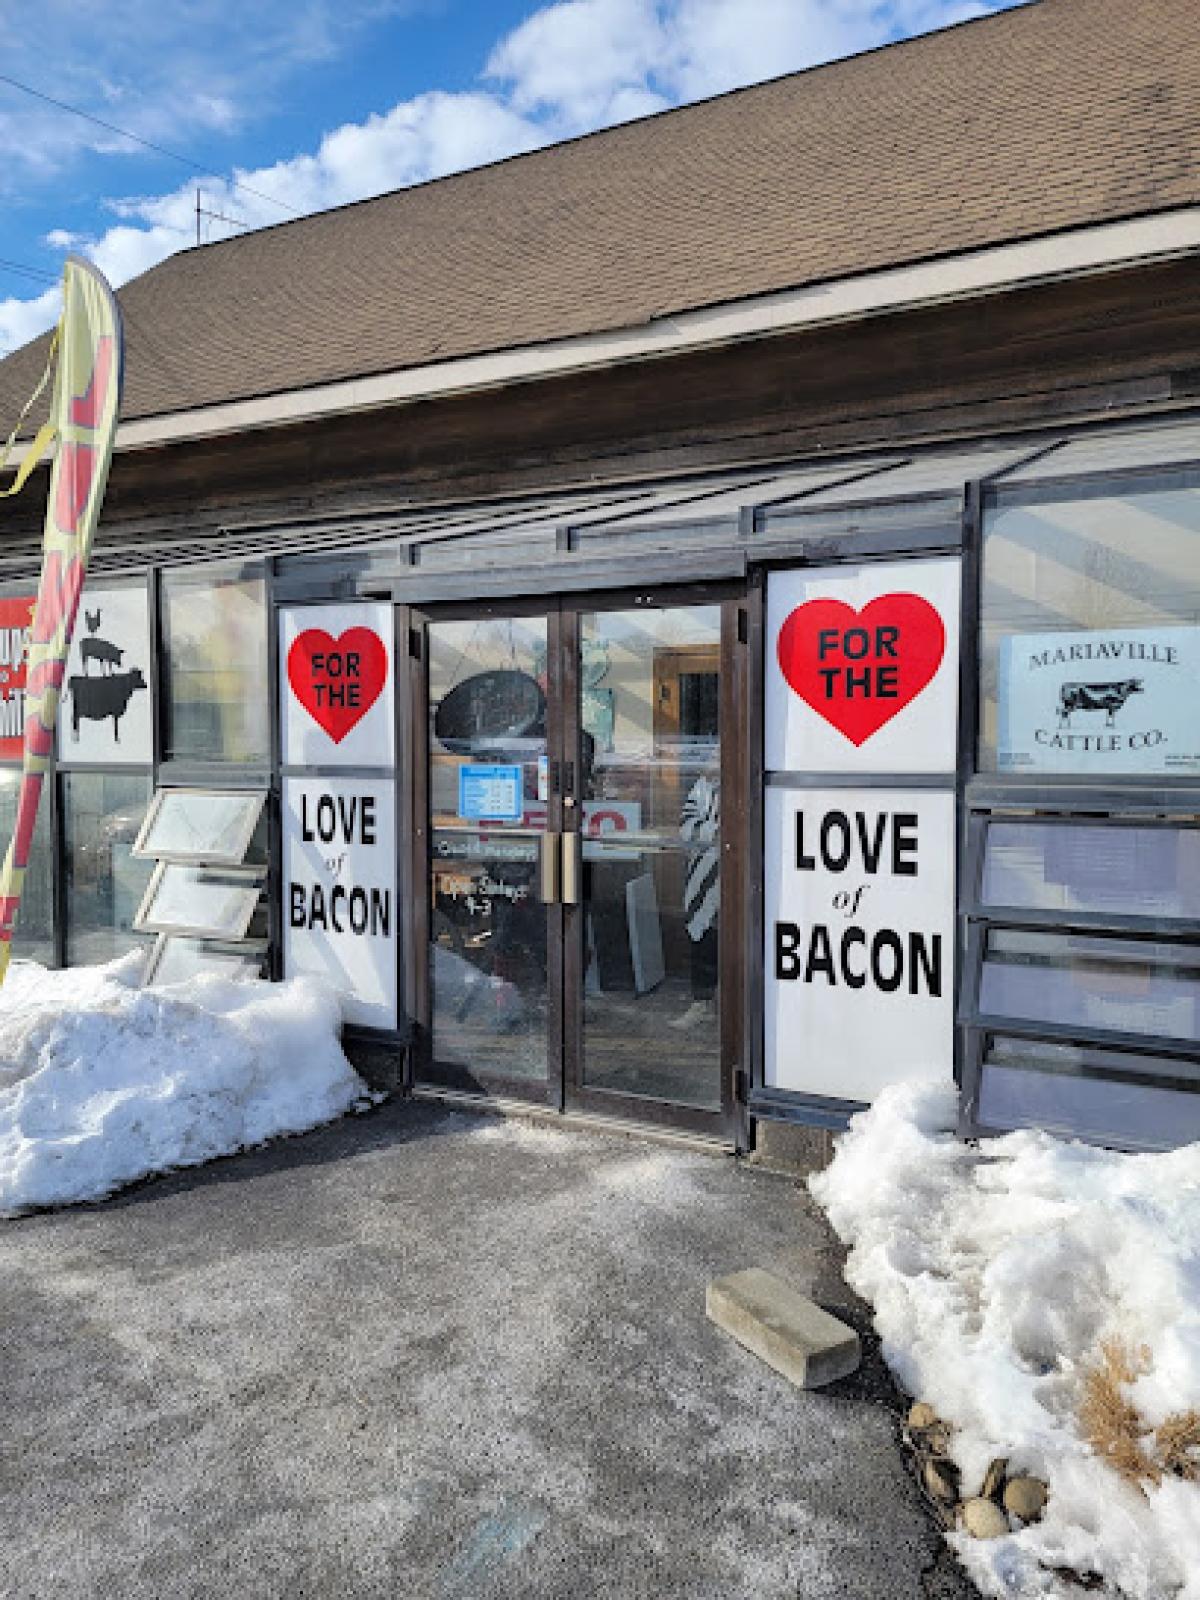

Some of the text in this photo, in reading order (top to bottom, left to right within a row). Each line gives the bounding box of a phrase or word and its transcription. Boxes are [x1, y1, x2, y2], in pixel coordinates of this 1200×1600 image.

[819, 626, 900, 661] FOR
[1030, 641, 1180, 669] MARIAVILLE
[311, 651, 361, 678] FOR
[312, 684, 361, 708] THE
[819, 665, 899, 699] THE
[1035, 729, 1169, 751] CATTLE CO.
[302, 793, 376, 845] LOVE
[796, 810, 919, 877] LOVE
[326, 853, 348, 878] of
[289, 881, 391, 938] BACON
[831, 884, 871, 918] of
[775, 920, 942, 998] BACON
